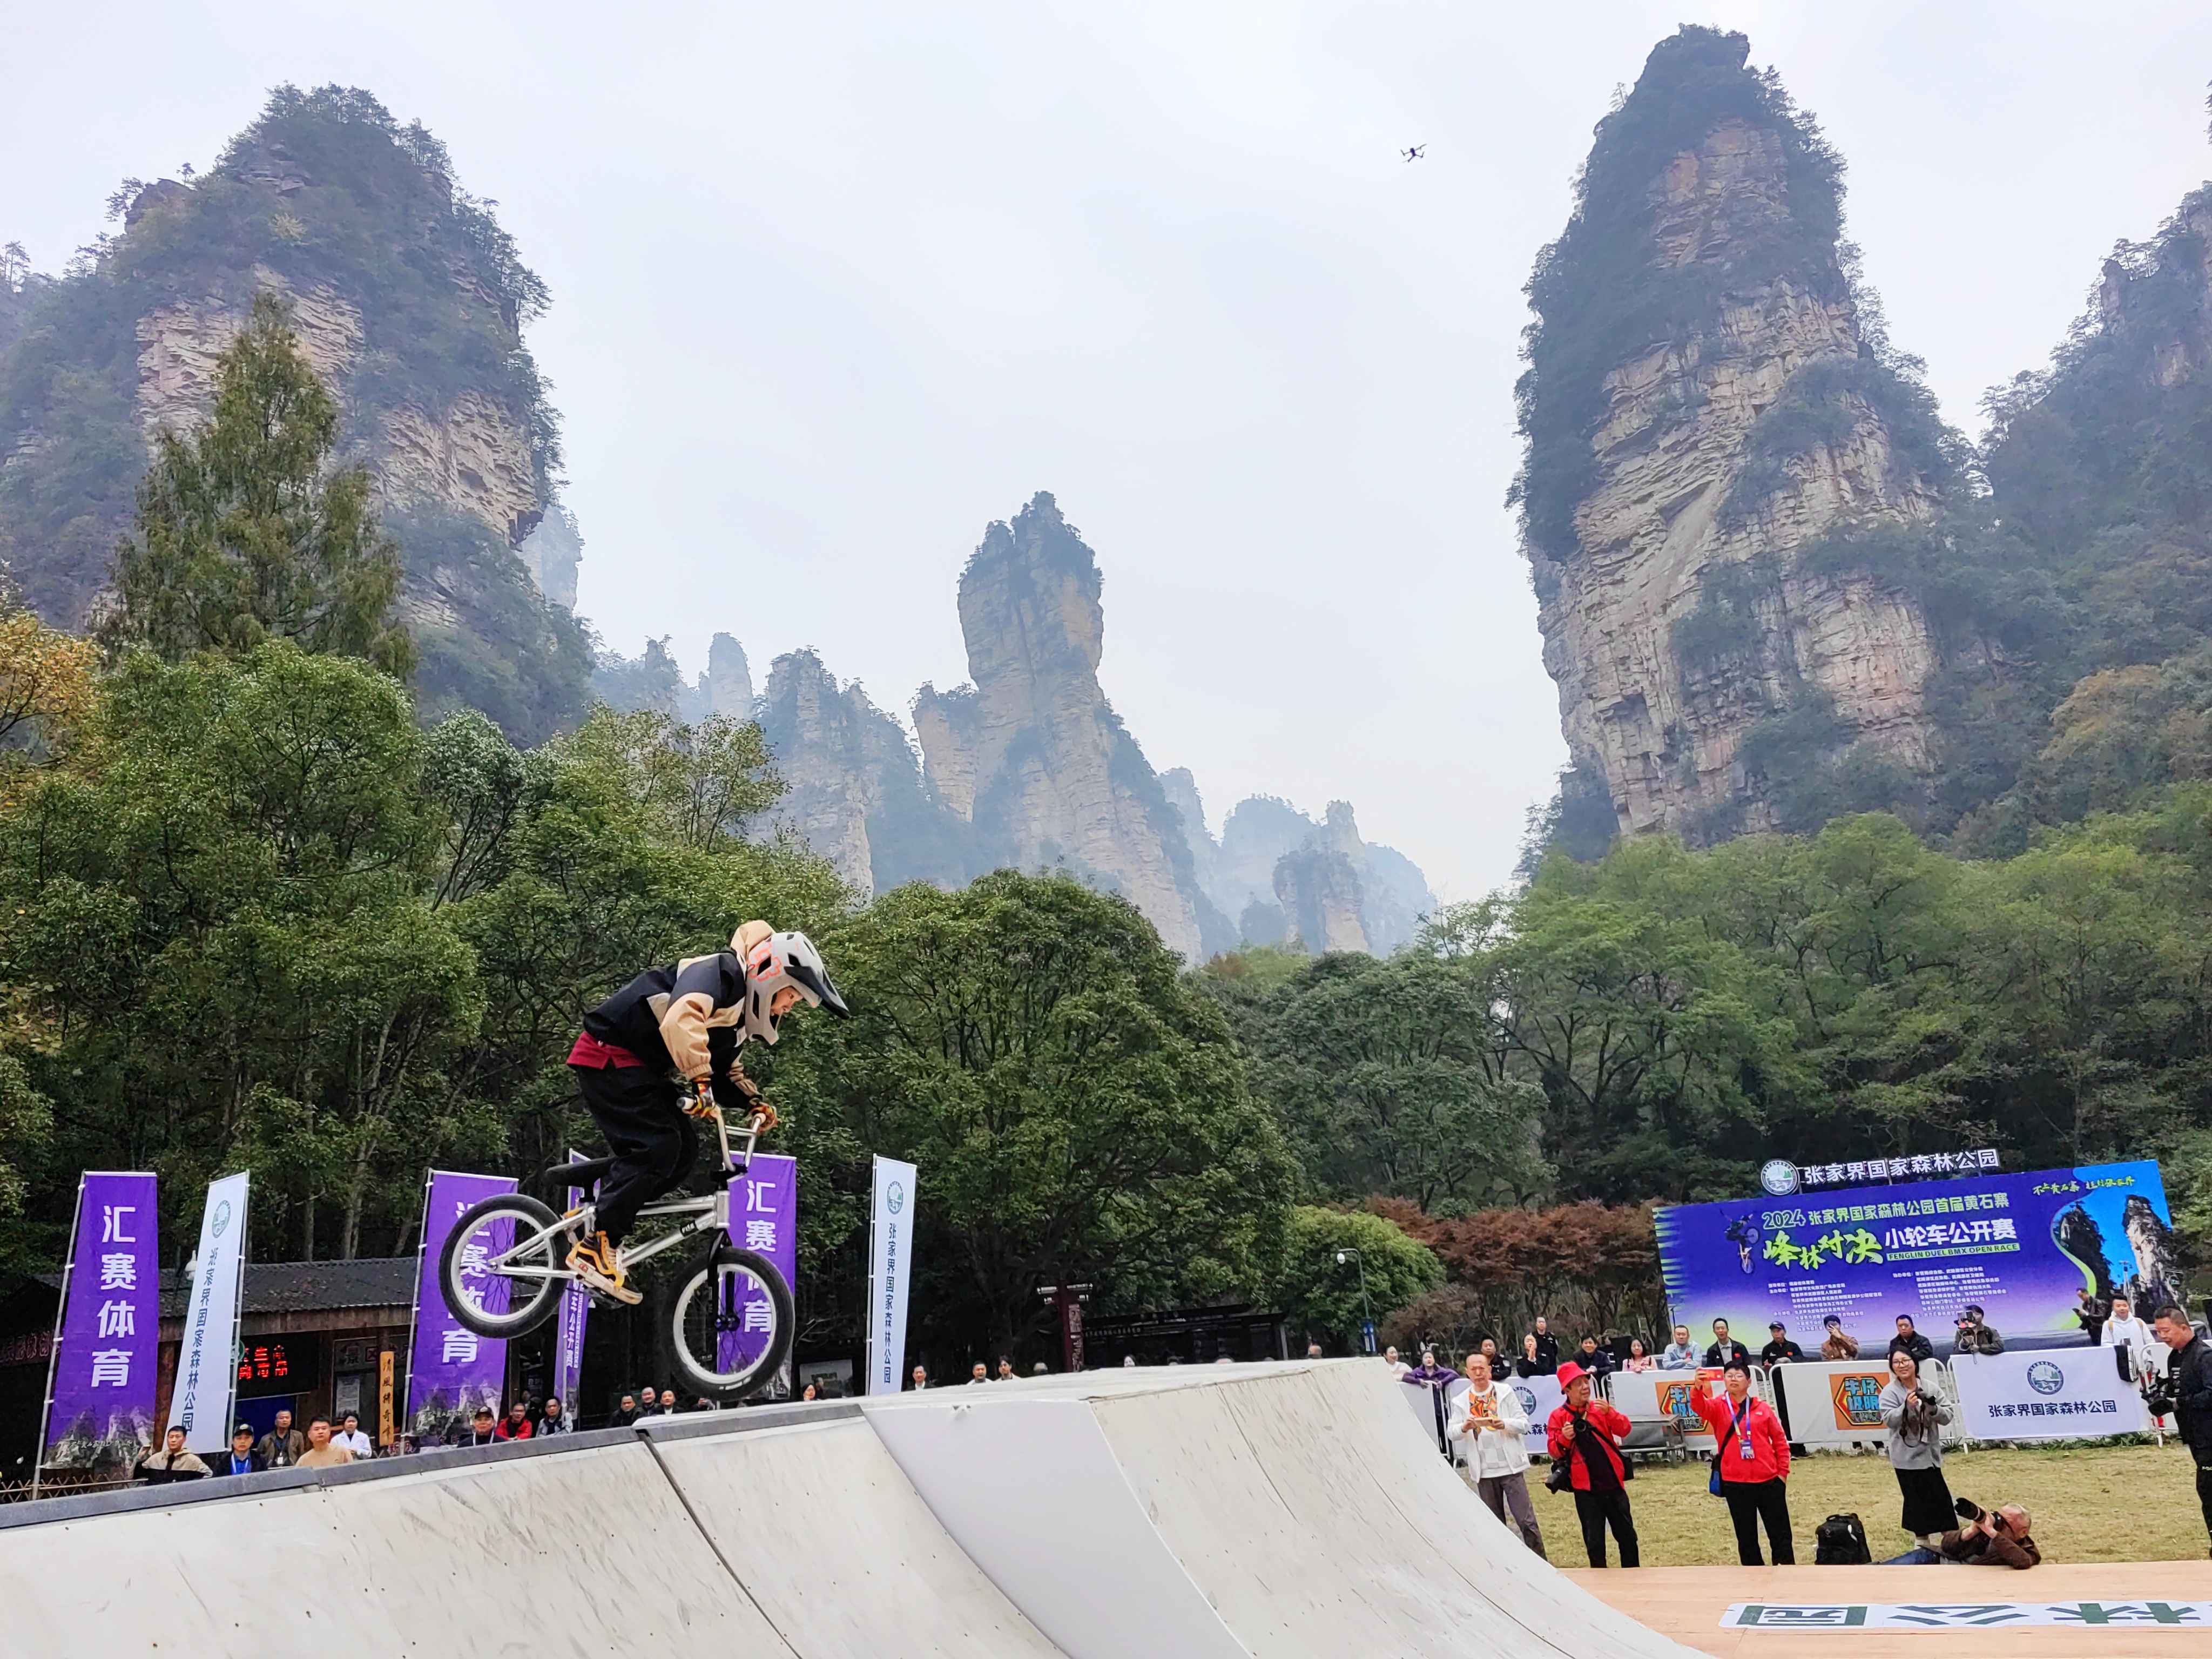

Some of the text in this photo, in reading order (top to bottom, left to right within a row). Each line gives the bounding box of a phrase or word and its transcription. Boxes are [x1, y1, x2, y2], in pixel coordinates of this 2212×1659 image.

[1804, 1149, 1999, 1184] 张家界国家森林公园
[1762, 1192, 2009, 1230] 2024 张家界国家森林公园首届黄石寨
[1762, 1228, 1884, 1270] 峰林对决
[1885, 1218, 2018, 1249] 小轮车公开赛
[1889, 1252, 1924, 1260] FENGLIN
[1969, 1245, 1993, 1253] OPEN
[743, 1180, 777, 1333] 汇赛育
[91, 1205, 137, 1387] 汇赛体育
[884, 1223, 896, 1384] 张家界国家森林公园
[1988, 1400, 2117, 1417] 张家界国家森林公园
